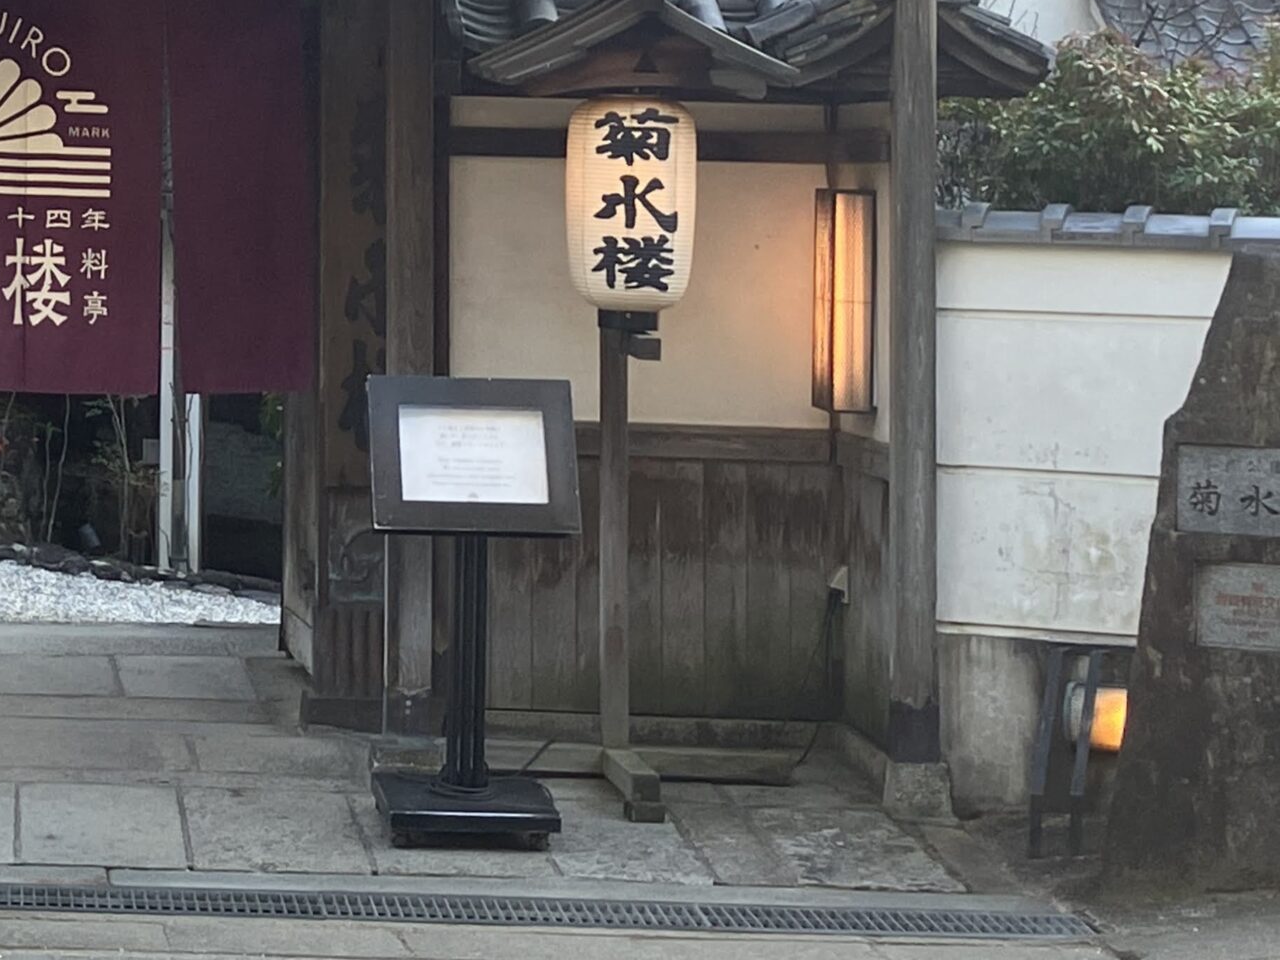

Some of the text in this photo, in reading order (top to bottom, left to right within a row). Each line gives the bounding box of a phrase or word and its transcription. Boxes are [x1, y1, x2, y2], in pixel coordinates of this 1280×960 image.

[68, 126, 110, 139] MARK
[591, 108, 679, 291] 菊水楼
